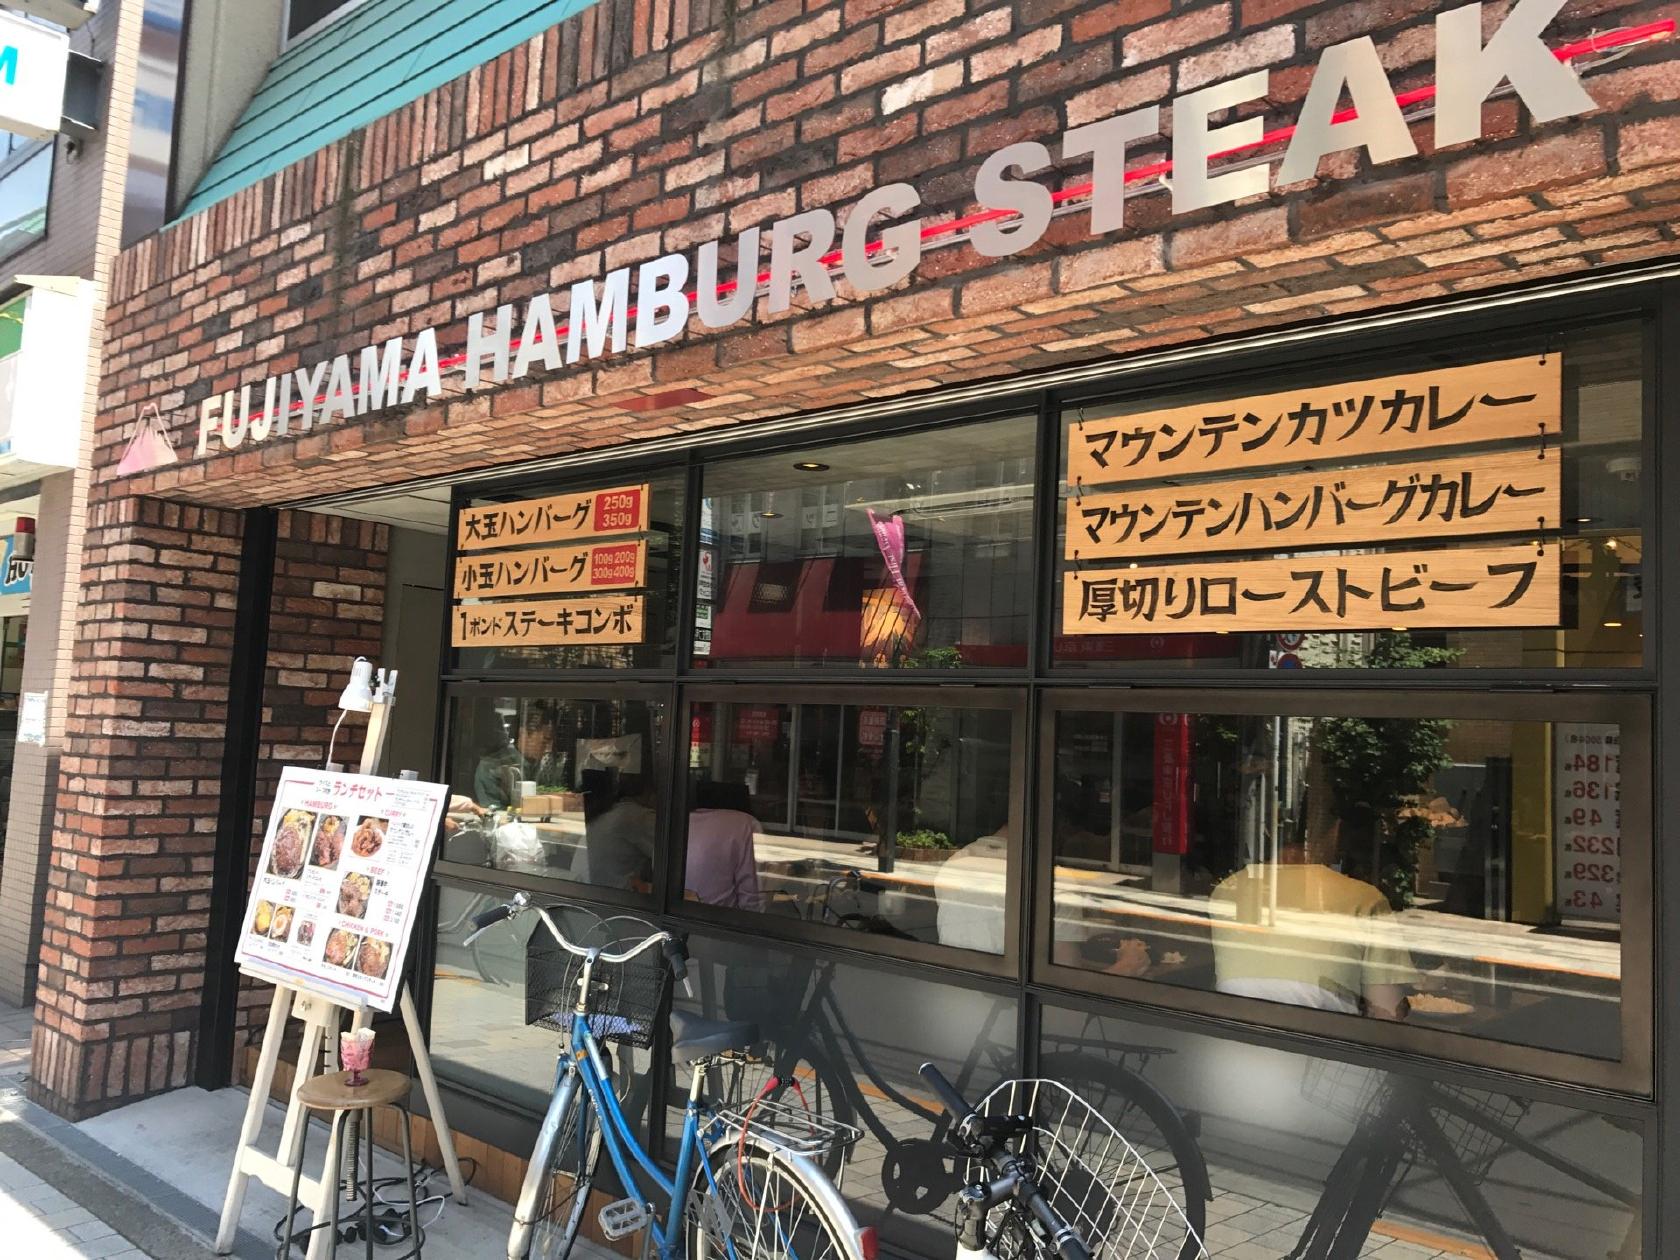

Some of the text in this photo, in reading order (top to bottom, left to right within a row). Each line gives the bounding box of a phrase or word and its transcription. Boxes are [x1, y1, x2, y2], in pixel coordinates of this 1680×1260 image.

[196, 0, 1599, 457] FUJIYAMA HAMBURG STEAK
[1084, 386, 1538, 468] マウンテンカツカレー
[465, 499, 592, 542] 大玉ハンバーグ
[602, 512, 632, 528] 350g
[603, 494, 634, 511] 250g
[1081, 471, 1546, 544] マウンテンハンバーグカレー
[461, 552, 588, 592] 小玉ハンバーグ
[593, 566, 635, 579] 300g 400g
[594, 551, 635, 565] 100g 200g
[1078, 561, 1538, 621] 厚切りローストビーフ
